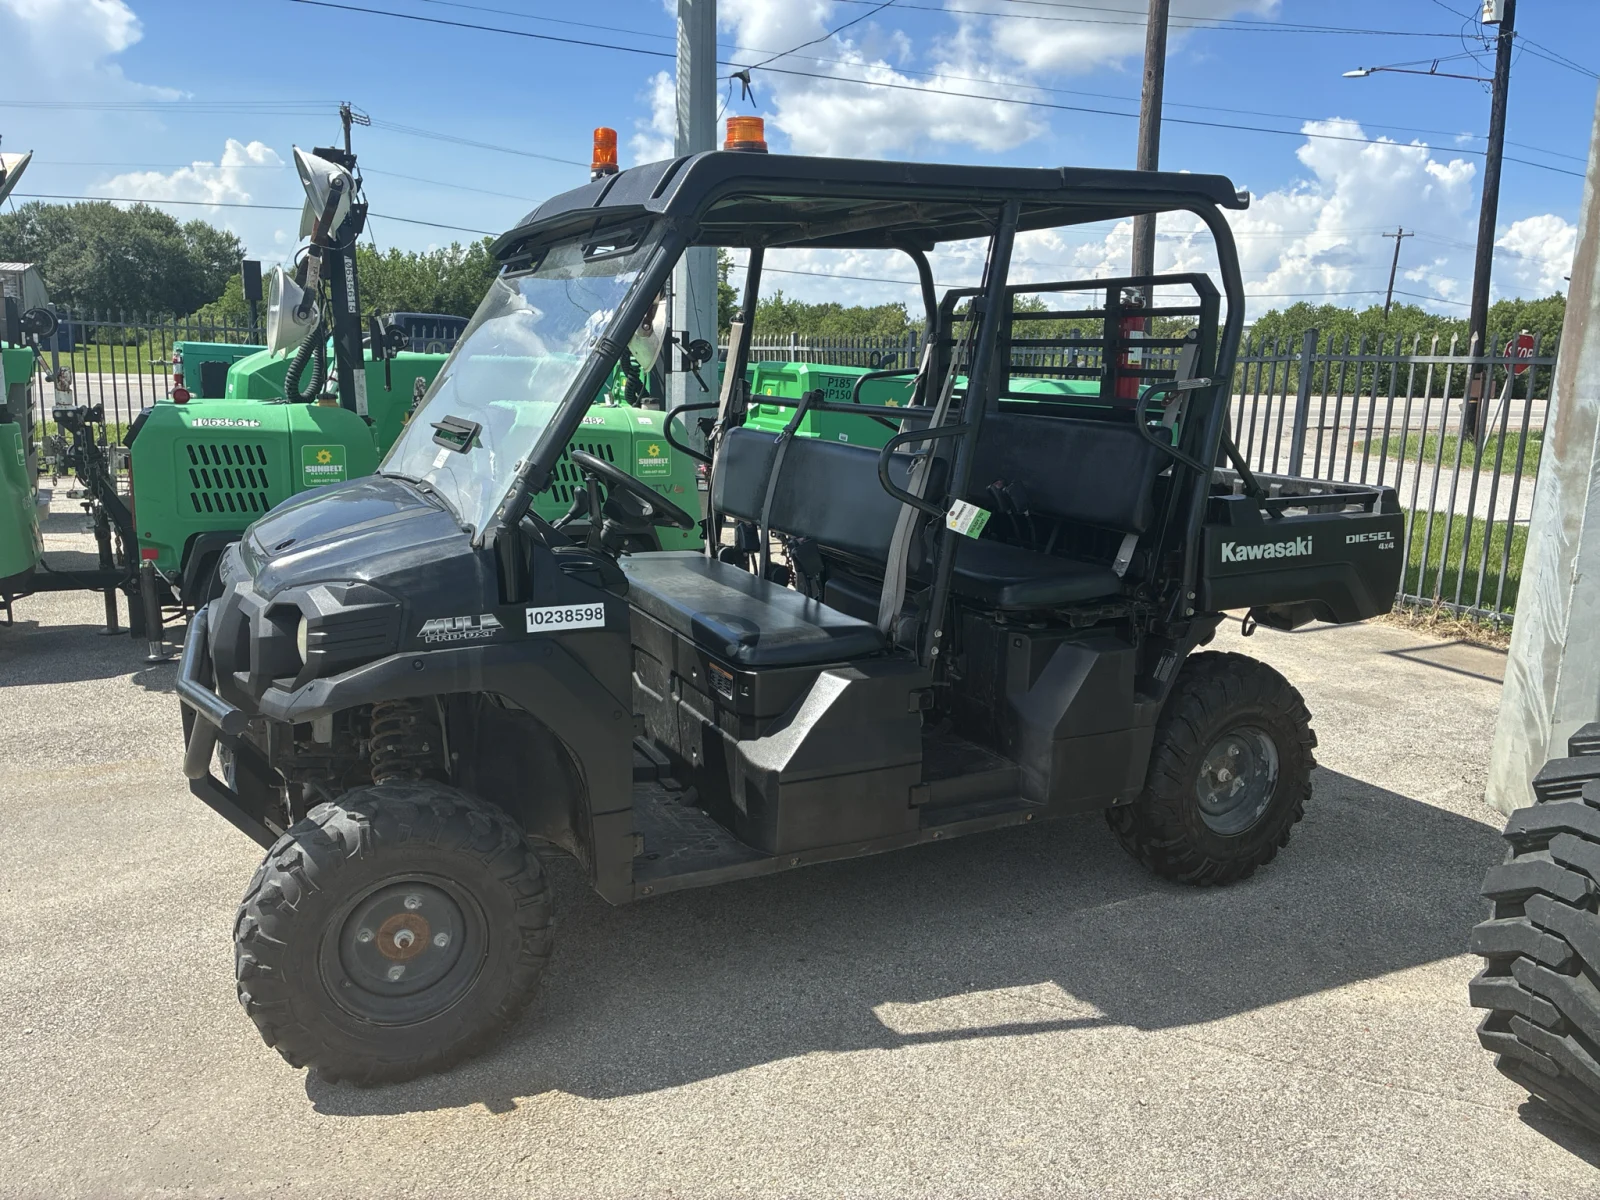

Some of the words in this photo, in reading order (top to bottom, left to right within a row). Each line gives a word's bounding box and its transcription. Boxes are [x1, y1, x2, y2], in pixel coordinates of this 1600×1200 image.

[828, 377, 851, 388] P185
[192, 418, 261, 427] 10635615
[1345, 531, 1395, 544] DIESEL
[1221, 535, 1313, 563] Kawasaki
[1378, 542, 1395, 550] 4x4
[527, 607, 604, 626] 10238598
[416, 613, 504, 638] MULE
